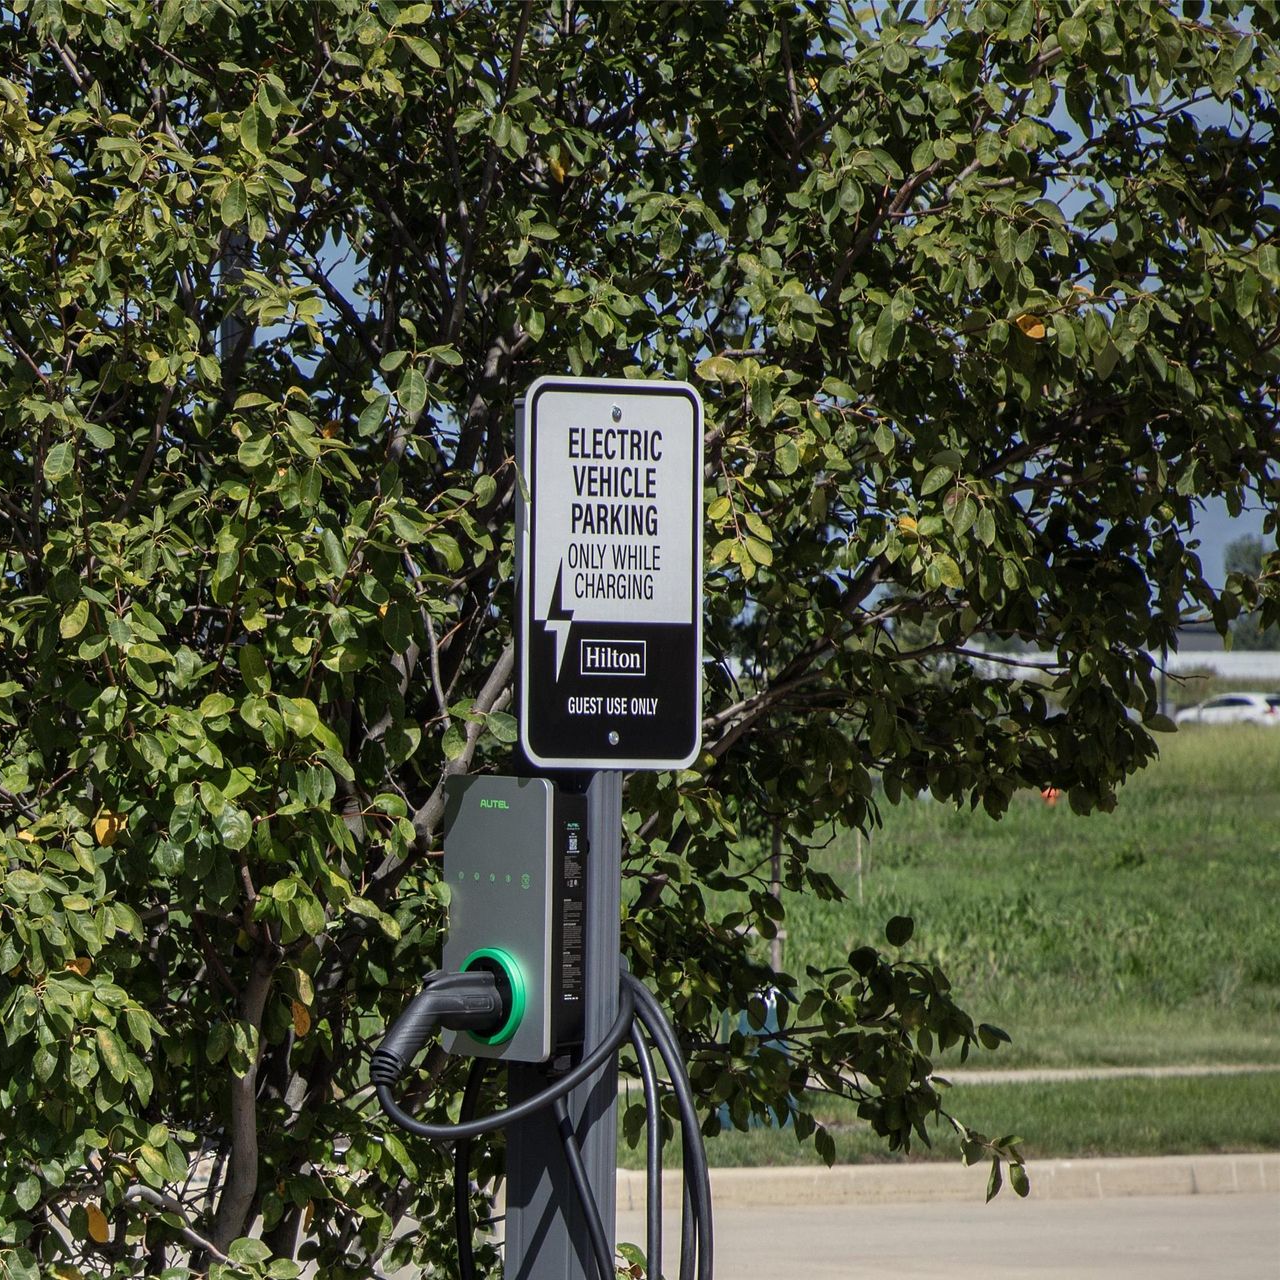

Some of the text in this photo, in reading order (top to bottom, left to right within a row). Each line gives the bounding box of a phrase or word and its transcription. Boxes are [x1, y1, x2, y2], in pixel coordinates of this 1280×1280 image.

[568, 427, 663, 462] ELECTRIC
[573, 465, 657, 499] VEHICLE
[571, 503, 658, 537] PARKING
[567, 543, 661, 572] ONLY WHILE
[574, 573, 654, 601] CHARGING
[586, 646, 641, 669] Hilton
[567, 697, 658, 716] GUEST USE ONLY
[480, 799, 509, 809] AUTEL
